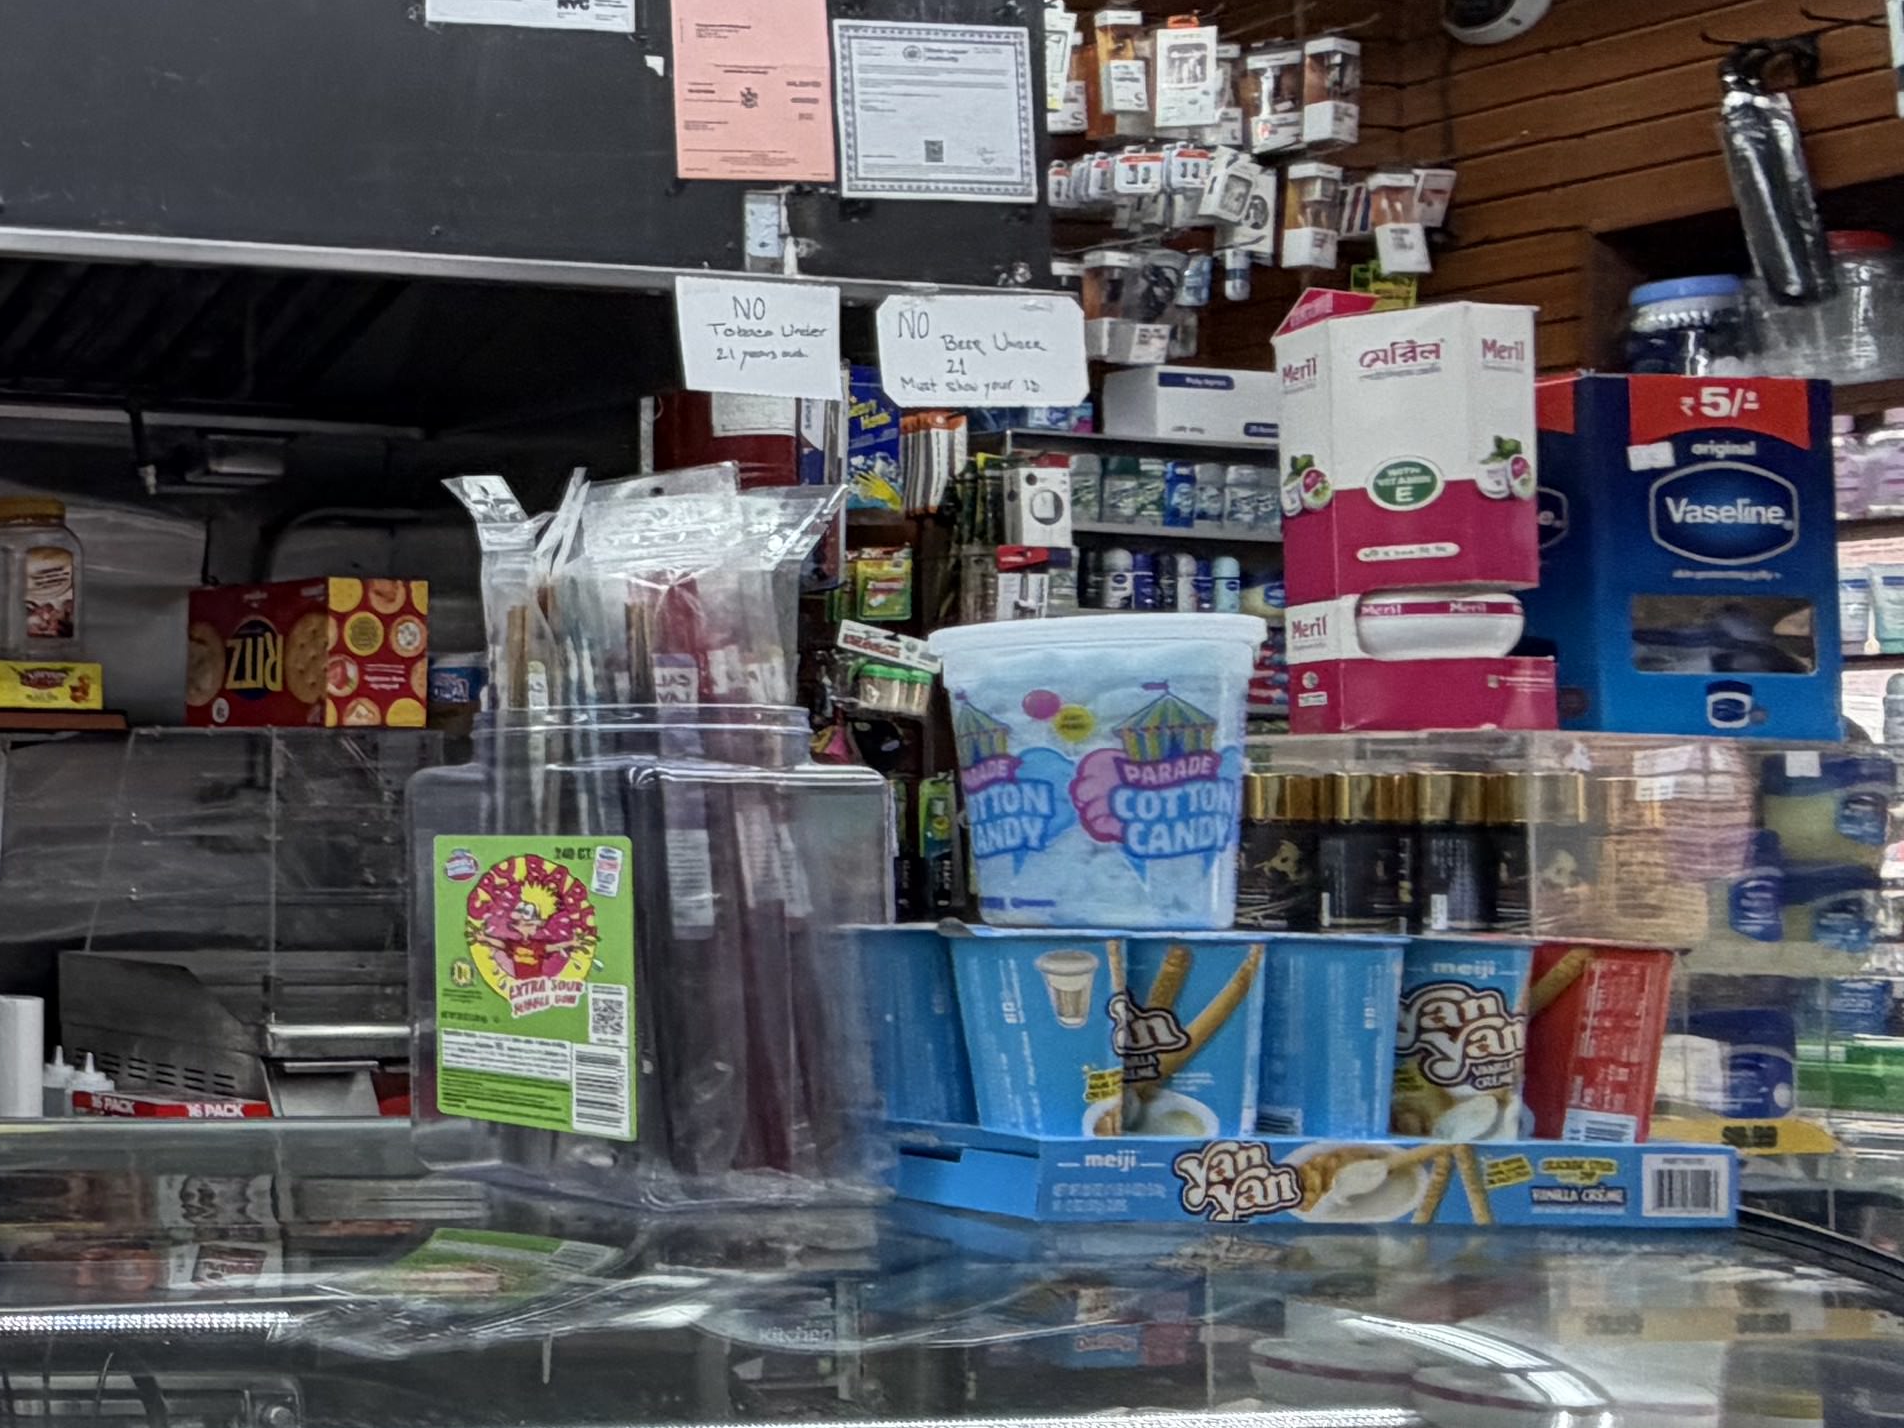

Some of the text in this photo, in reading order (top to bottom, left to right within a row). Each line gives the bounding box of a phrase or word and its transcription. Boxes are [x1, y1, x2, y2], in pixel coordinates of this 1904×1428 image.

[732, 295, 766, 321] NO
[898, 310, 930, 341] NO
[716, 348, 735, 361] 21
[1481, 338, 1525, 361] Meril
[946, 359, 967, 375] 21
[1282, 356, 1318, 384] Meril
[1691, 440, 1757, 458] original
[1395, 486, 1414, 503] E
[1664, 496, 1787, 525] Vaseline
[1291, 613, 1328, 640] Meril
[225, 631, 285, 692] RITZ
[1123, 757, 1214, 784] PARADE
[1113, 779, 1235, 822] COTTON
[976, 816, 1044, 851] ANDY
[1126, 814, 1229, 856] CANDY
[508, 980, 546, 1000] EXTRA
[103, 1097, 136, 1115] PACK
[204, 1103, 245, 1118] PACK
[1083, 1148, 1138, 1172] meiji
[758, 1323, 834, 1343] Kitchen
